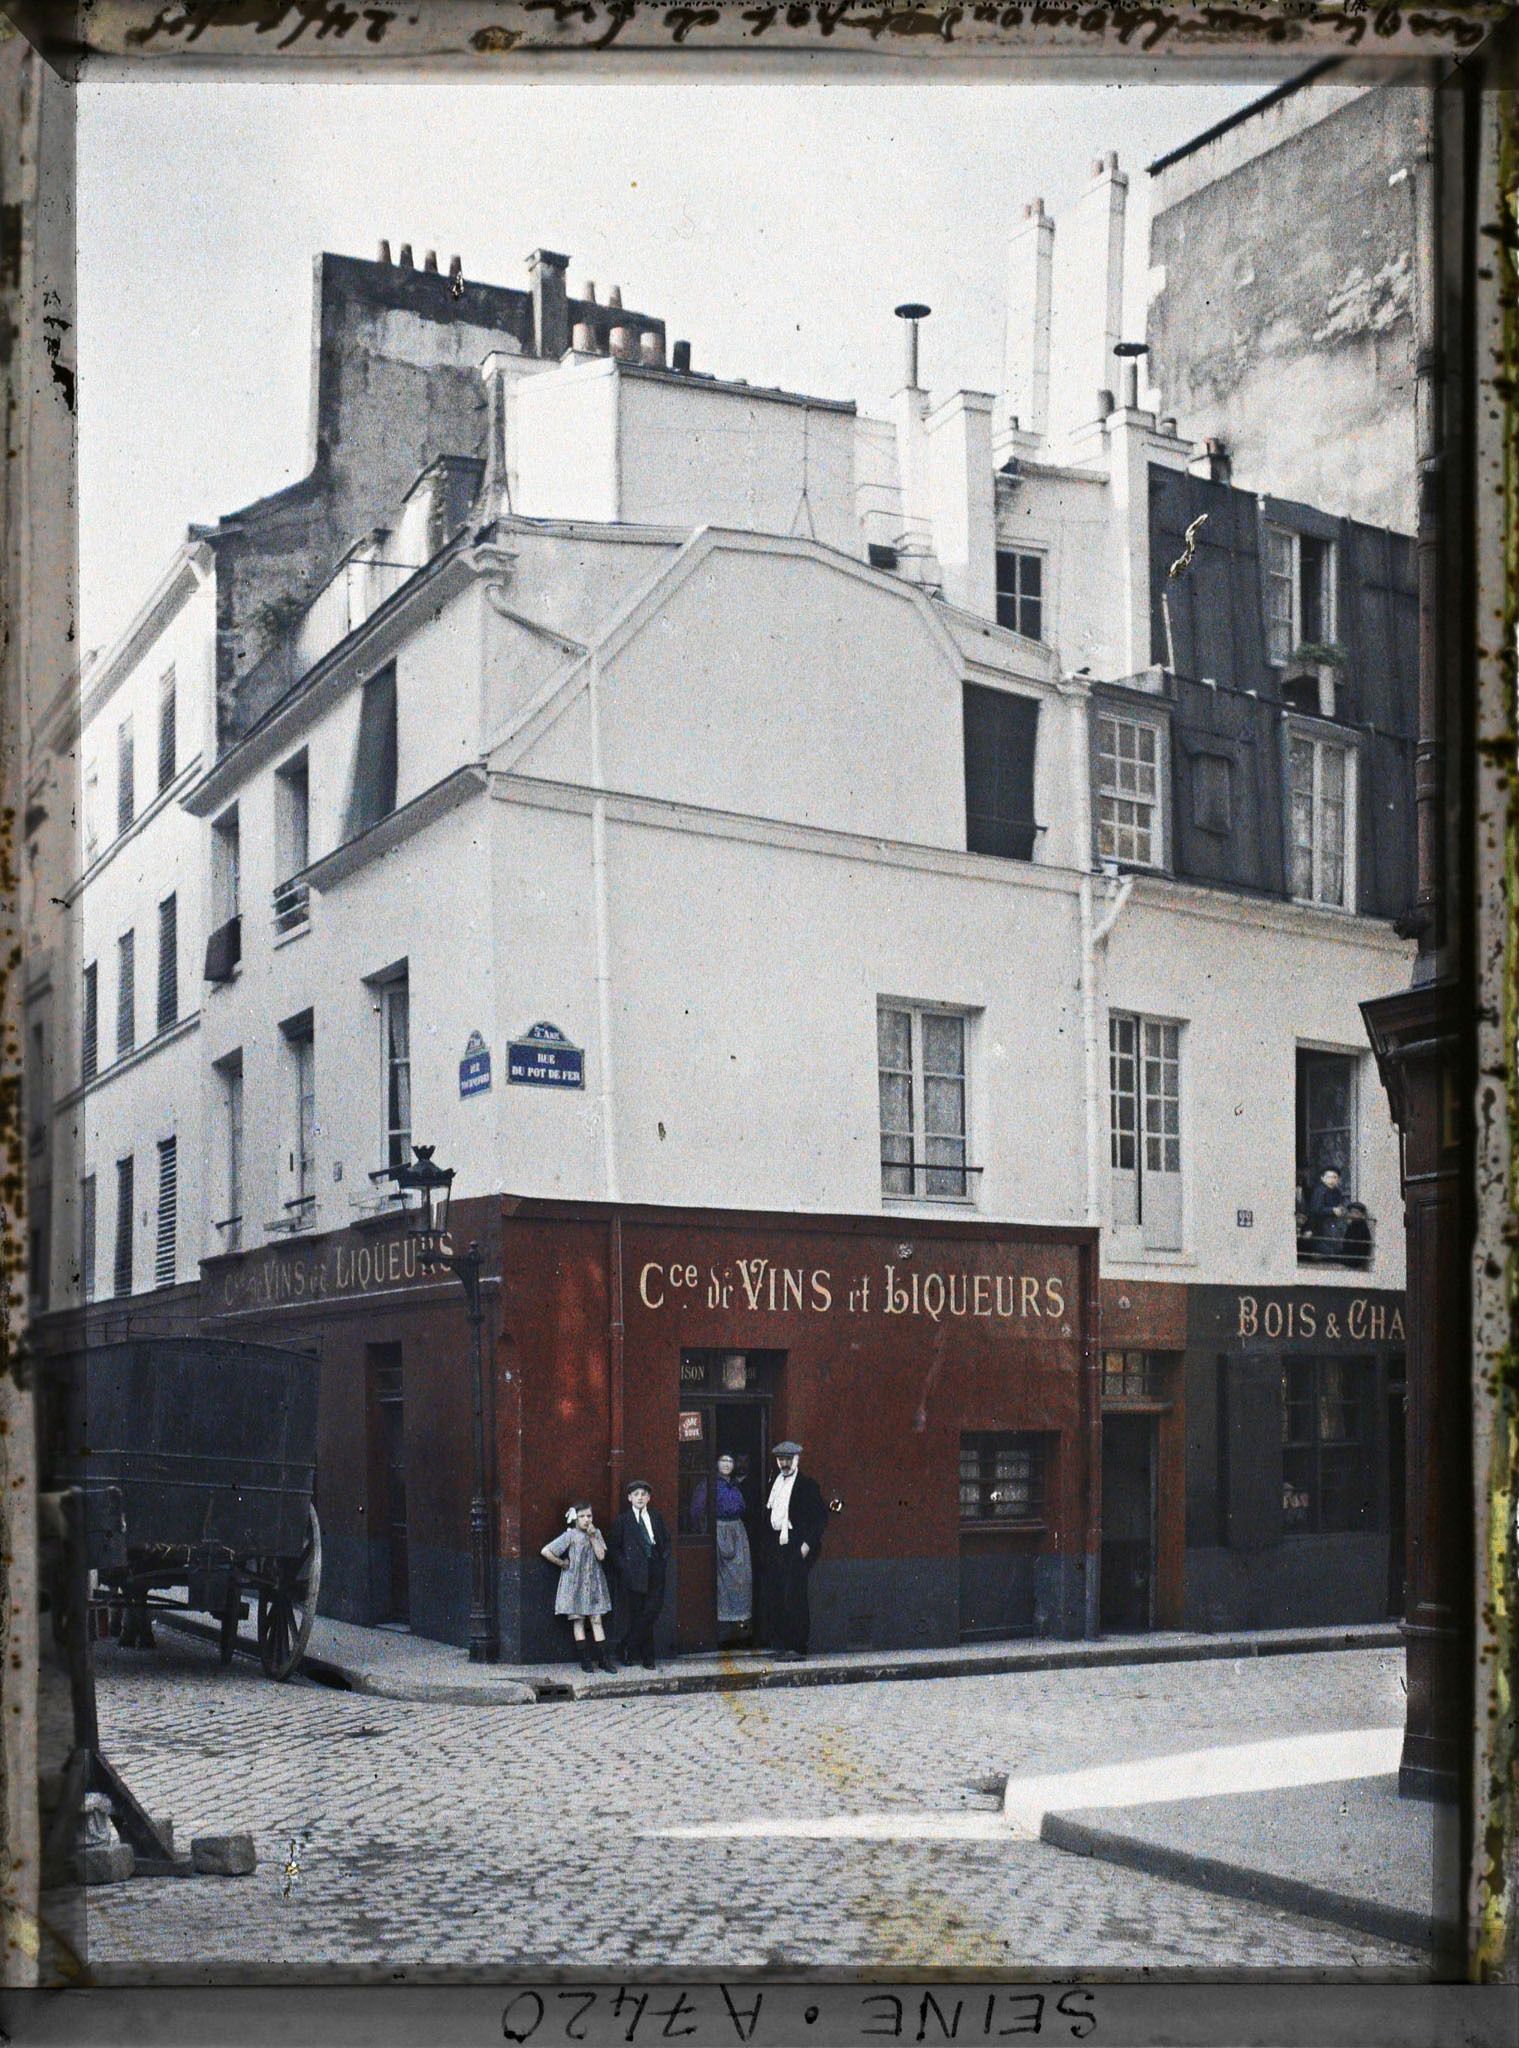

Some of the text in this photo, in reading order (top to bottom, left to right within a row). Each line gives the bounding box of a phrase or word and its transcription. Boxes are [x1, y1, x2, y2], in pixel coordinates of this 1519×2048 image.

[512, 1065, 581, 1081] DU POT DE FER
[537, 1053, 555, 1065] RUE
[263, 1259, 305, 1302] VINS
[735, 1258, 833, 1313] VINS
[848, 1275, 871, 1314] et
[884, 1265, 1065, 1324] LIQUEURS
[1236, 1295, 1406, 1340] BOIS & CHA
[859, 1986, 1098, 2038] SEINE
